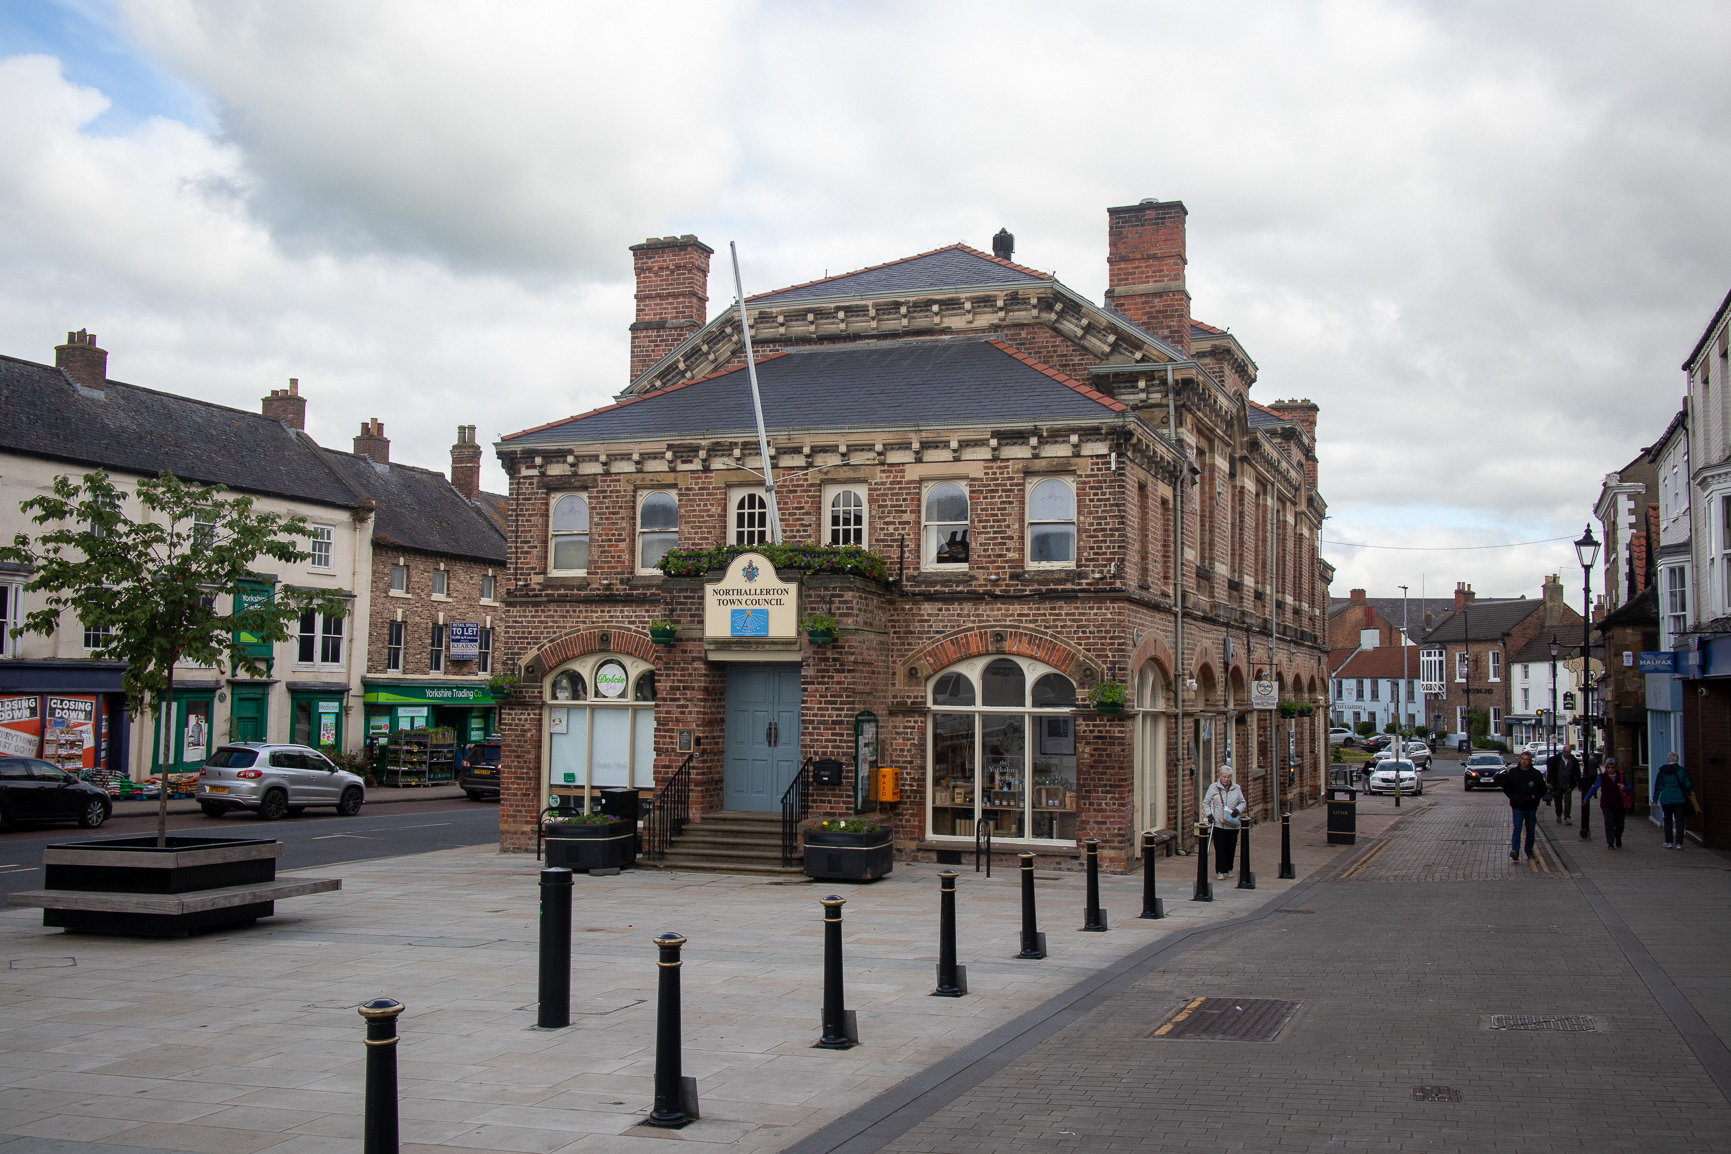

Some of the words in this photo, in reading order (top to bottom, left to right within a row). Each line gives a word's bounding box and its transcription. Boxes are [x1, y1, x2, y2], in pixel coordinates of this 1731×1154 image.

[712, 588, 789, 596] NORTHALLERTON
[717, 598, 743, 606] TOWN
[745, 598, 784, 606] COUNCIL
[452, 627, 462, 635] TO
[464, 627, 478, 635] LET
[597, 673, 625, 684] Dolcie
[425, 688, 452, 698] Yorkshire
[453, 689, 473, 700] Trading
[473, 689, 482, 697] Co.
[0, 699, 36, 710] LOSING
[50, 700, 92, 711] CLOSING
[55, 710, 86, 720] DOWN
[0, 730, 37, 747] ERYTHING
